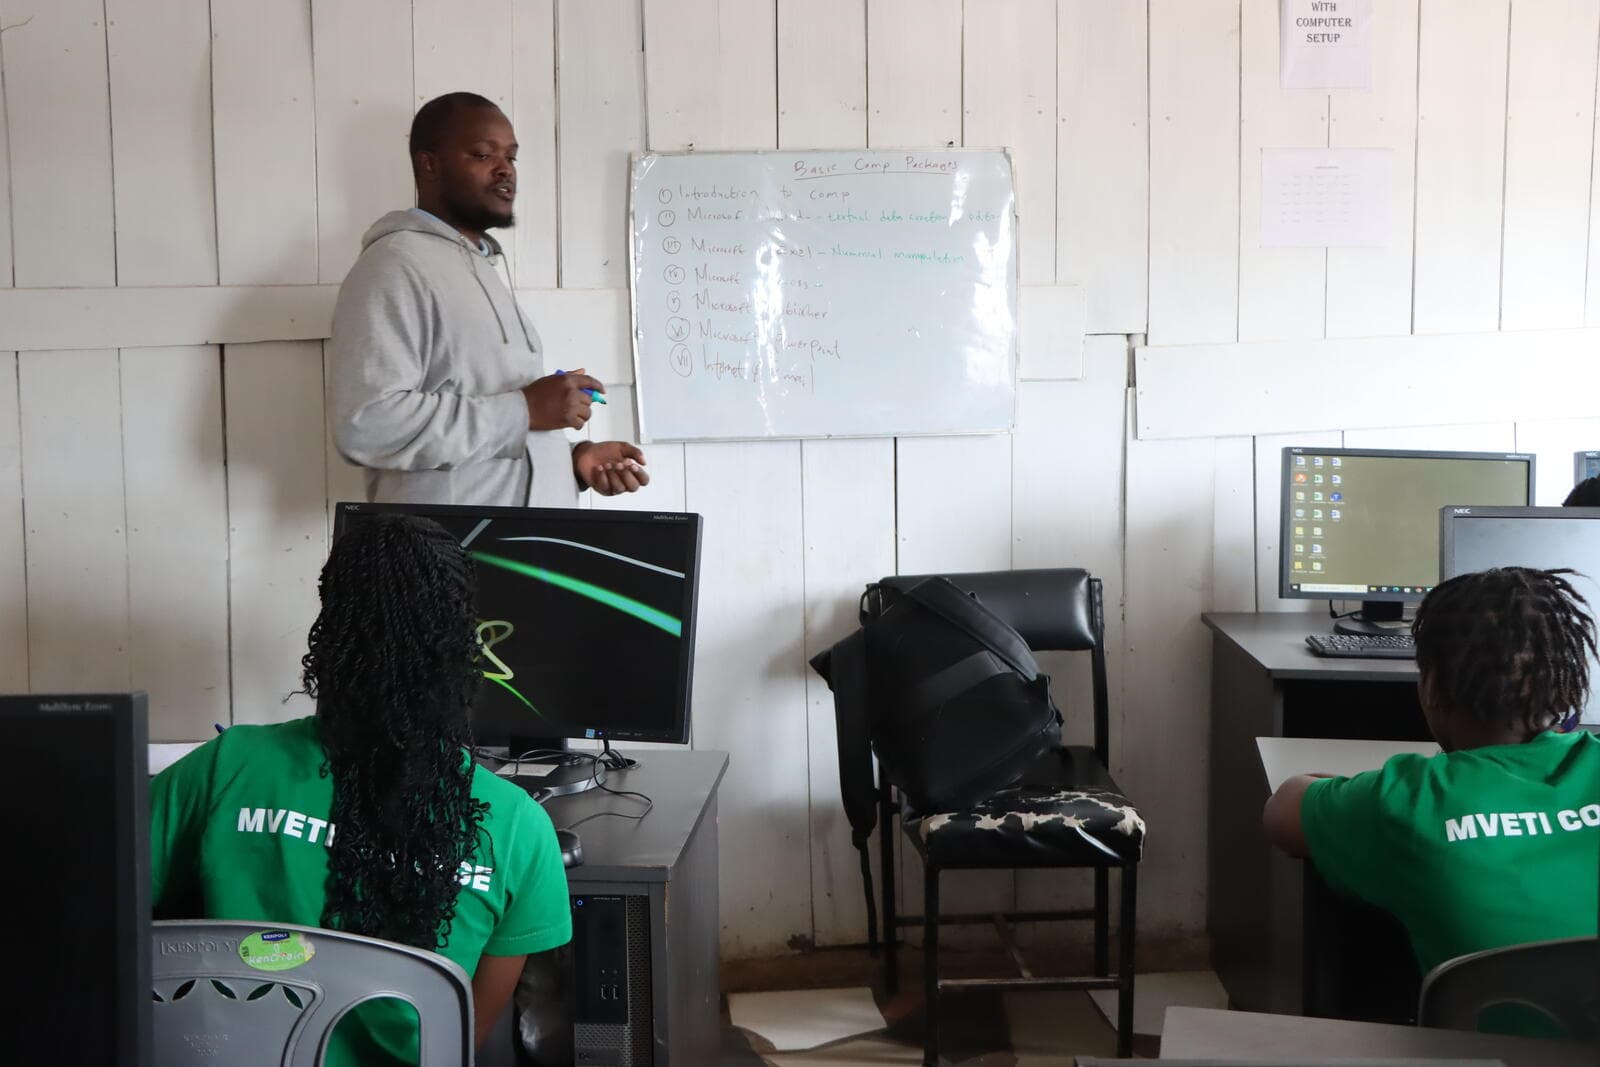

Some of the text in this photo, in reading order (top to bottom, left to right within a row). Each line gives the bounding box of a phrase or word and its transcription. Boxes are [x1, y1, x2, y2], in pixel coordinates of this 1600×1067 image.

[1311, 2, 1337, 12] WITH
[1295, 17, 1353, 28] COMPUTER
[1306, 33, 1341, 43] SETUP
[793, 160, 837, 177] Basic
[679, 184, 760, 200] Introduction
[780, 185, 793, 199] to
[237, 807, 336, 848] MVETI
[1445, 812, 1553, 842] MVETI
